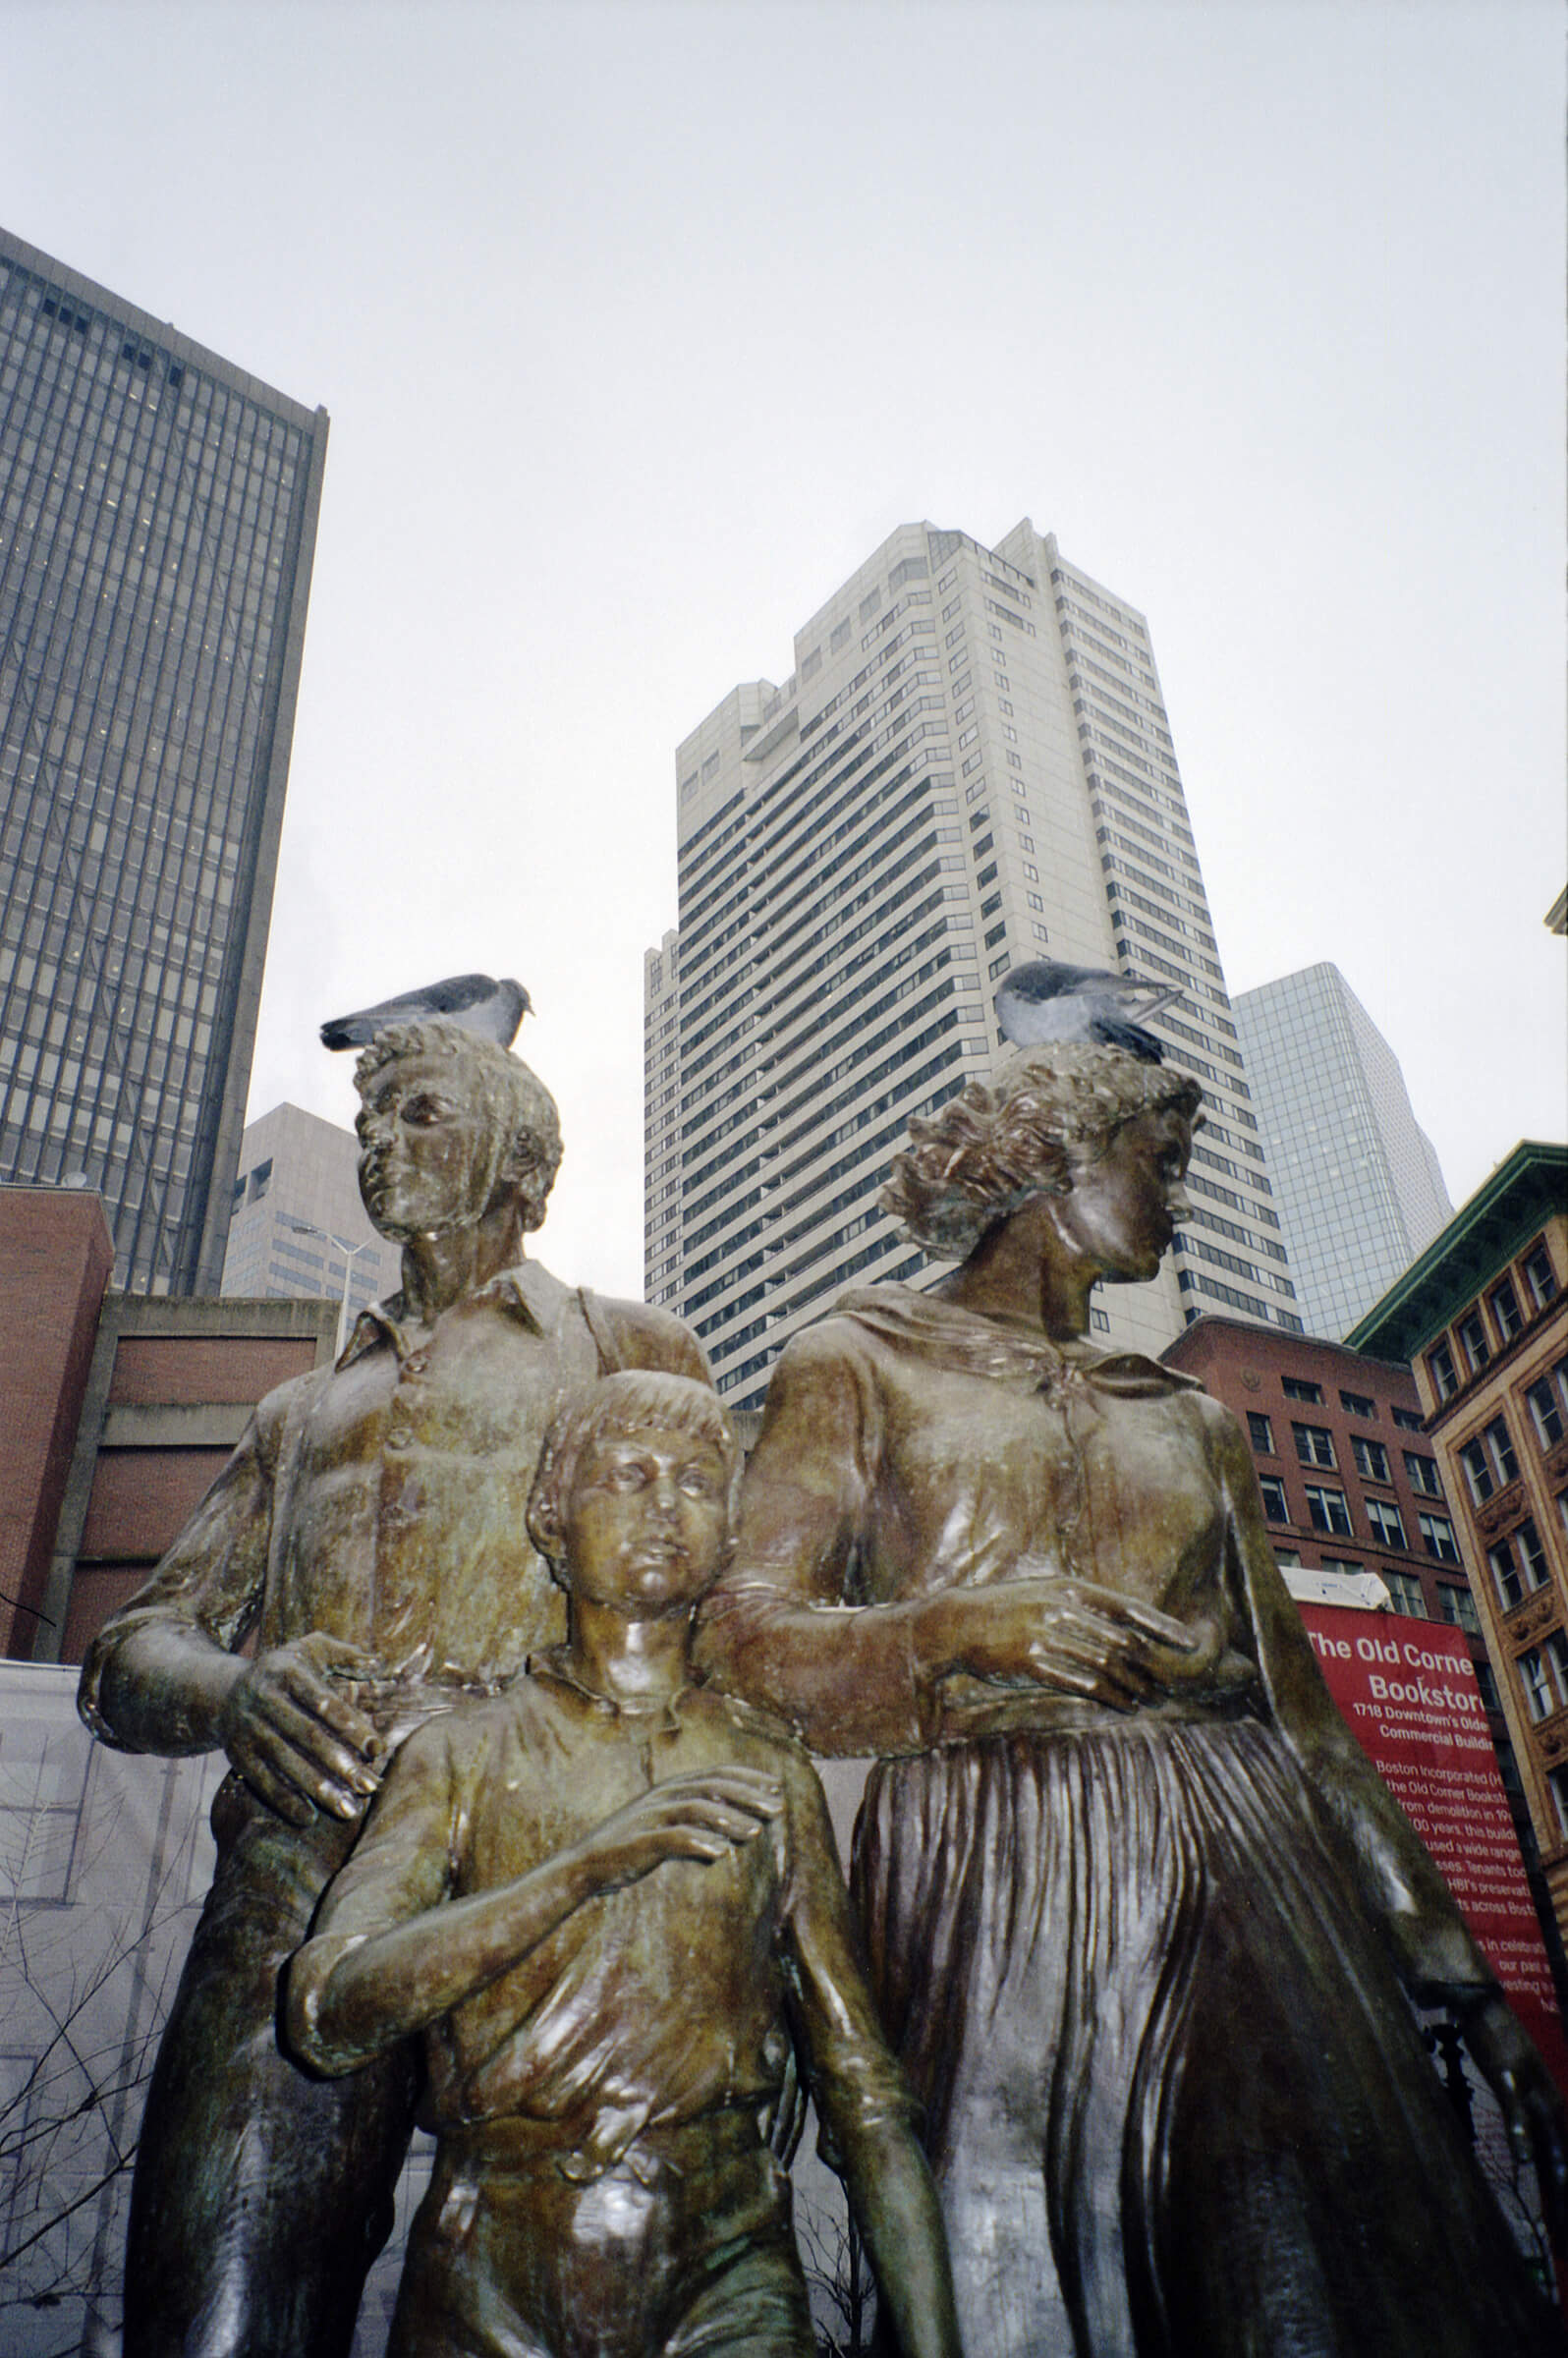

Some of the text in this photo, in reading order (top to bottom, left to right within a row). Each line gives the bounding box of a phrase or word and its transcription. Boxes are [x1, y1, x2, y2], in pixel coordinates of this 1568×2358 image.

[1307, 1632, 1475, 1677] The Old Corne
[1353, 1703, 1382, 1717] 1718
[1384, 1706, 1459, 1729] Downtown's
[1379, 1724, 1454, 1747] Commercial
[1375, 1760, 1419, 1776] Boston
[1420, 1765, 1487, 1784] Incorporated
[1386, 1779, 1408, 1793] the
[1409, 1781, 1428, 1795] Old
[1429, 1783, 1465, 1801] Corner
[1428, 1802, 1483, 1821] demolition
[1484, 1809, 1494, 1822] in
[1409, 1818, 1429, 1832] 00
[1465, 1824, 1485, 1838] this
[1456, 1842, 1463, 1854] a
[1463, 1843, 1489, 1856] wide
[1465, 1860, 1507, 1878] Tenants
[1471, 1901, 1507, 1914] across
